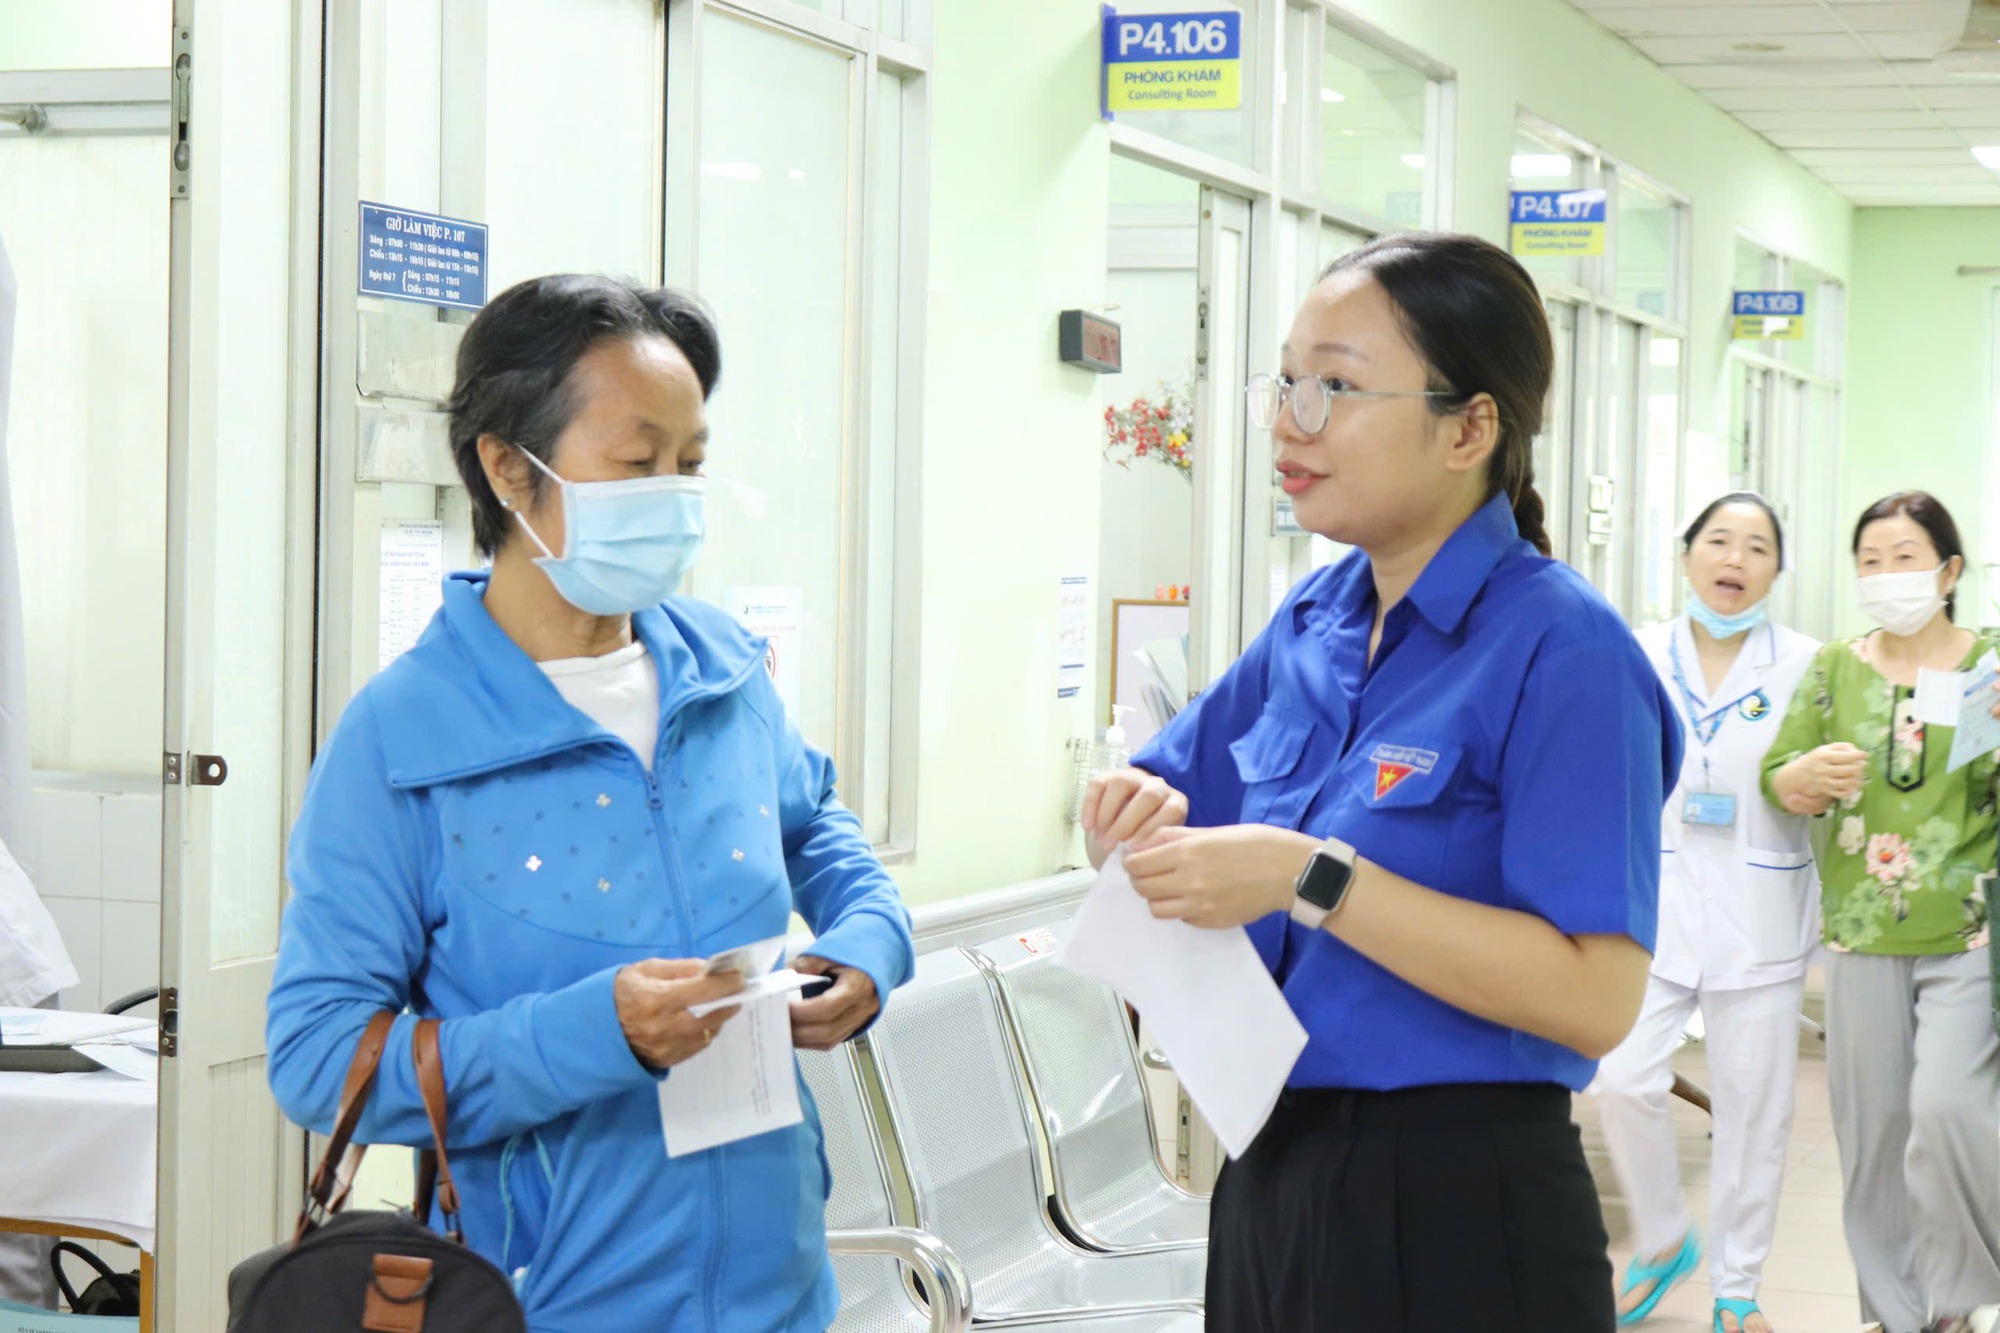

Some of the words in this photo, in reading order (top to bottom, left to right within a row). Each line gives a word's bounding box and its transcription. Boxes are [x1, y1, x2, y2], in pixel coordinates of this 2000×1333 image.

[1119, 19, 1228, 56] P4.106
[1124, 70, 1175, 84] PHÒNG
[1177, 66, 1221, 82] KHÁM
[1128, 89, 1184, 101] Consulting
[1186, 88, 1217, 98] Room
[1518, 195, 1594, 219] P4.107
[386, 217, 402, 231] GIỜ
[403, 218, 422, 235] LÀM
[423, 223, 443, 239] VIỆC
[444, 228, 452, 239] P.
[454, 230, 466, 242] 107
[370, 234, 384, 247] Sáng
[368, 269, 383, 282] Ngày
